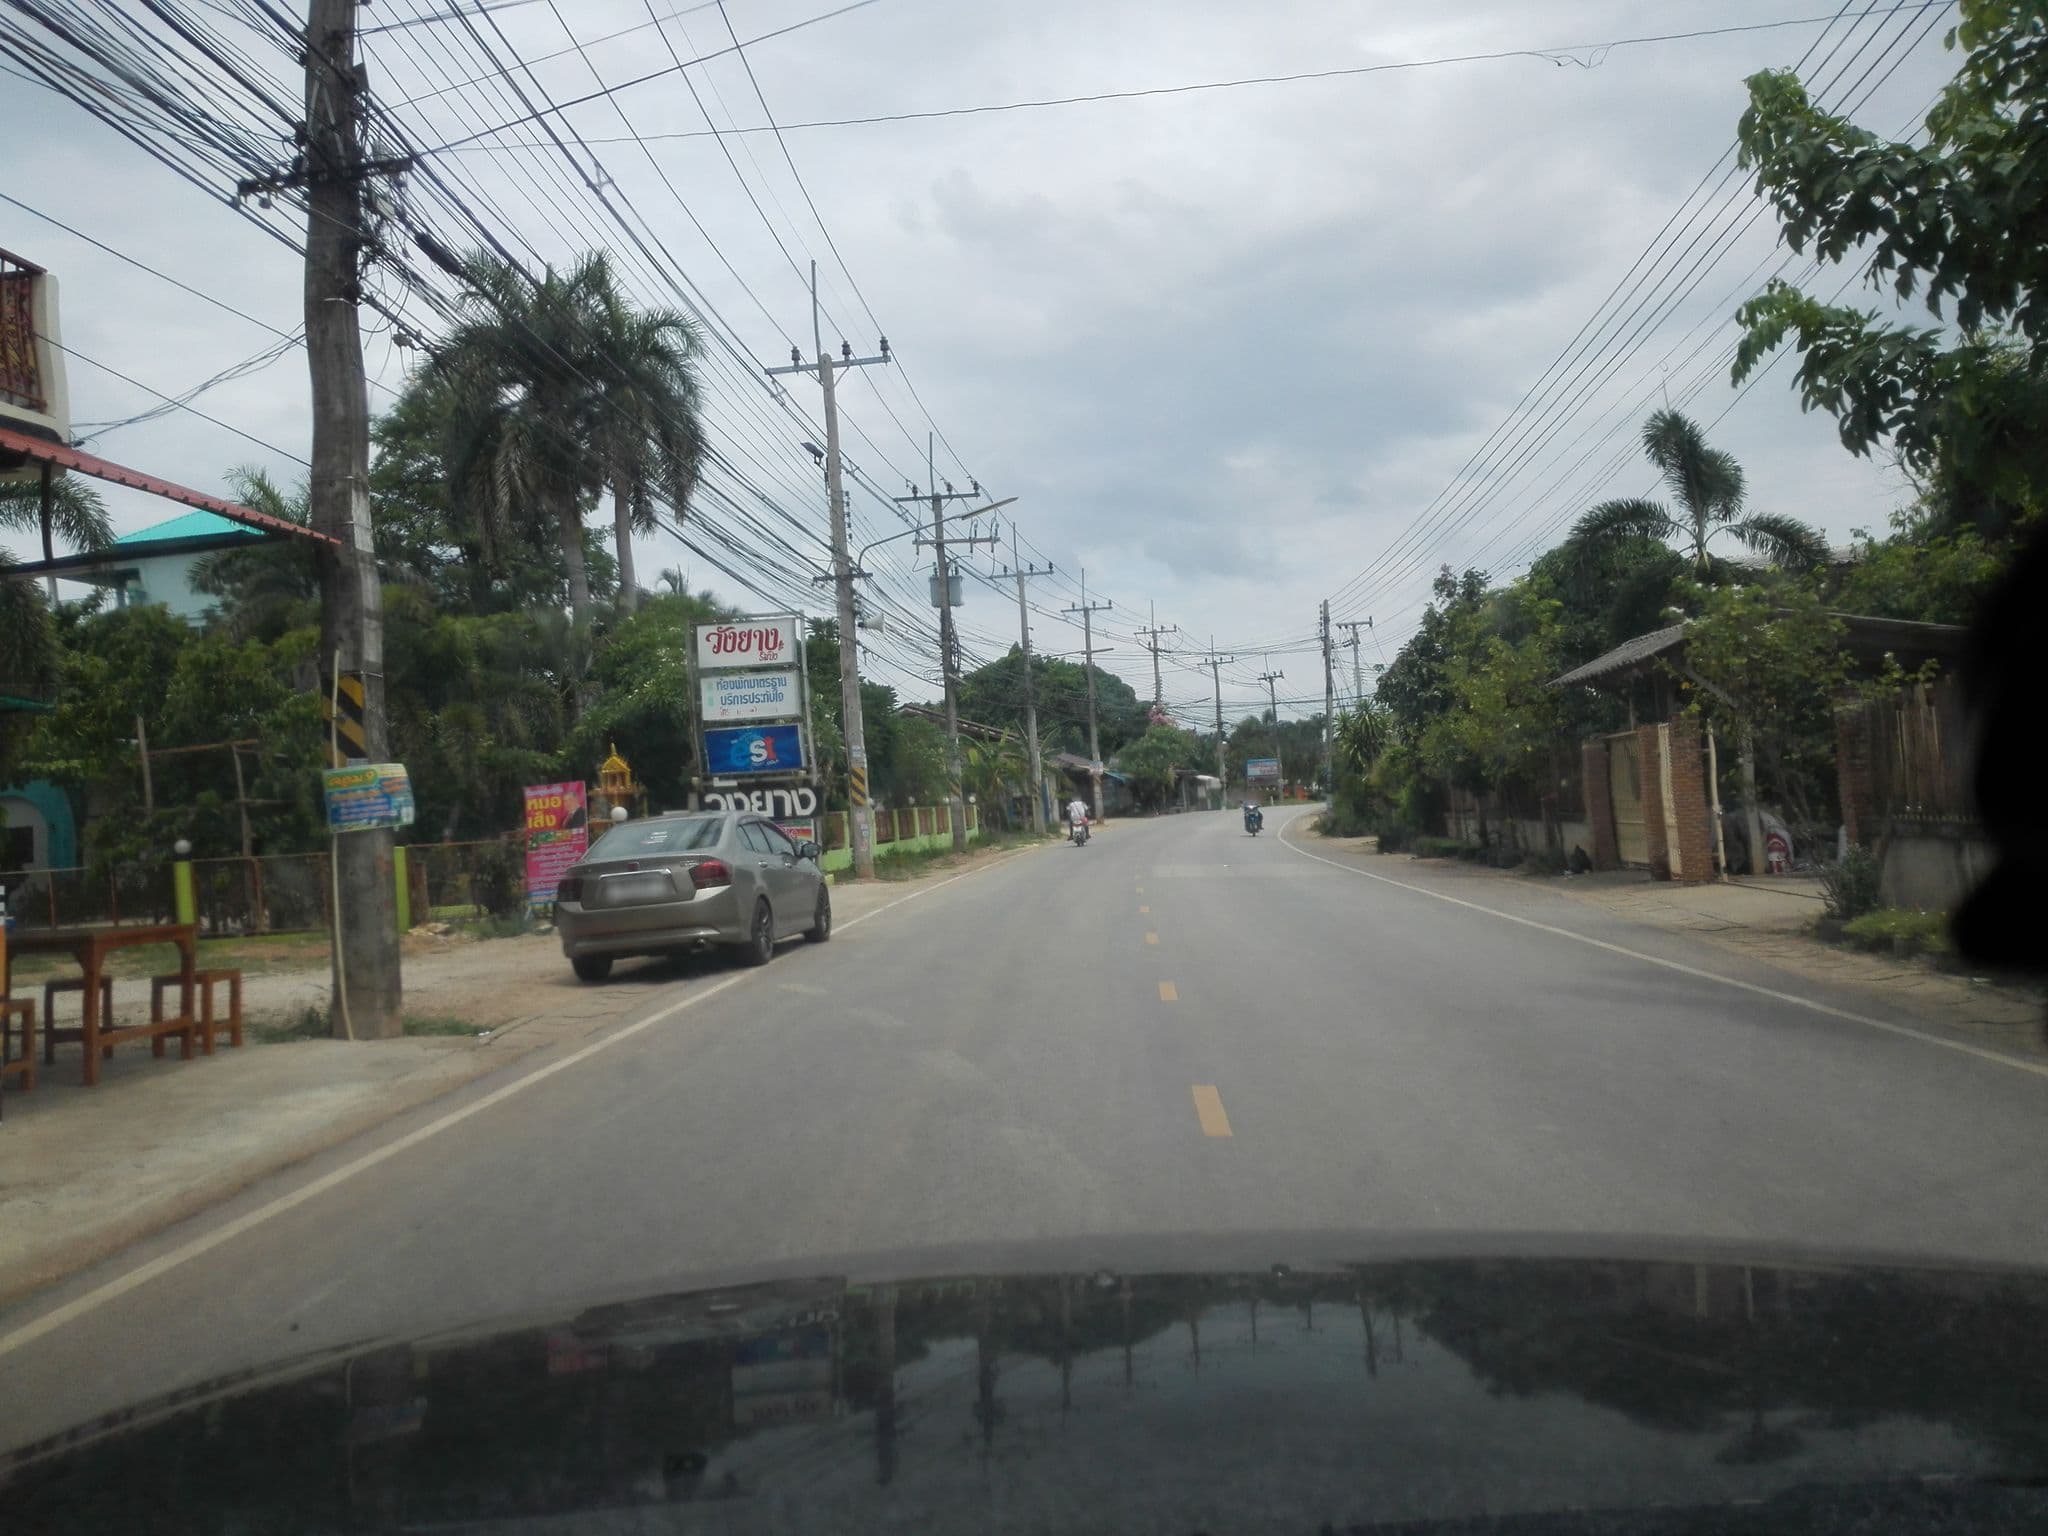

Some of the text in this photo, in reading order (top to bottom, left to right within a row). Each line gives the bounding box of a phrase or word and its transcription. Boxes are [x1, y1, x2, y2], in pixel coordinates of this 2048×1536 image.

[705, 626, 780, 654] วังยาง
[716, 676, 787, 692] ห้องพักมาตรฐาน
[720, 688, 784, 706] บริการประทับใจ
[731, 736, 777, 766] est
